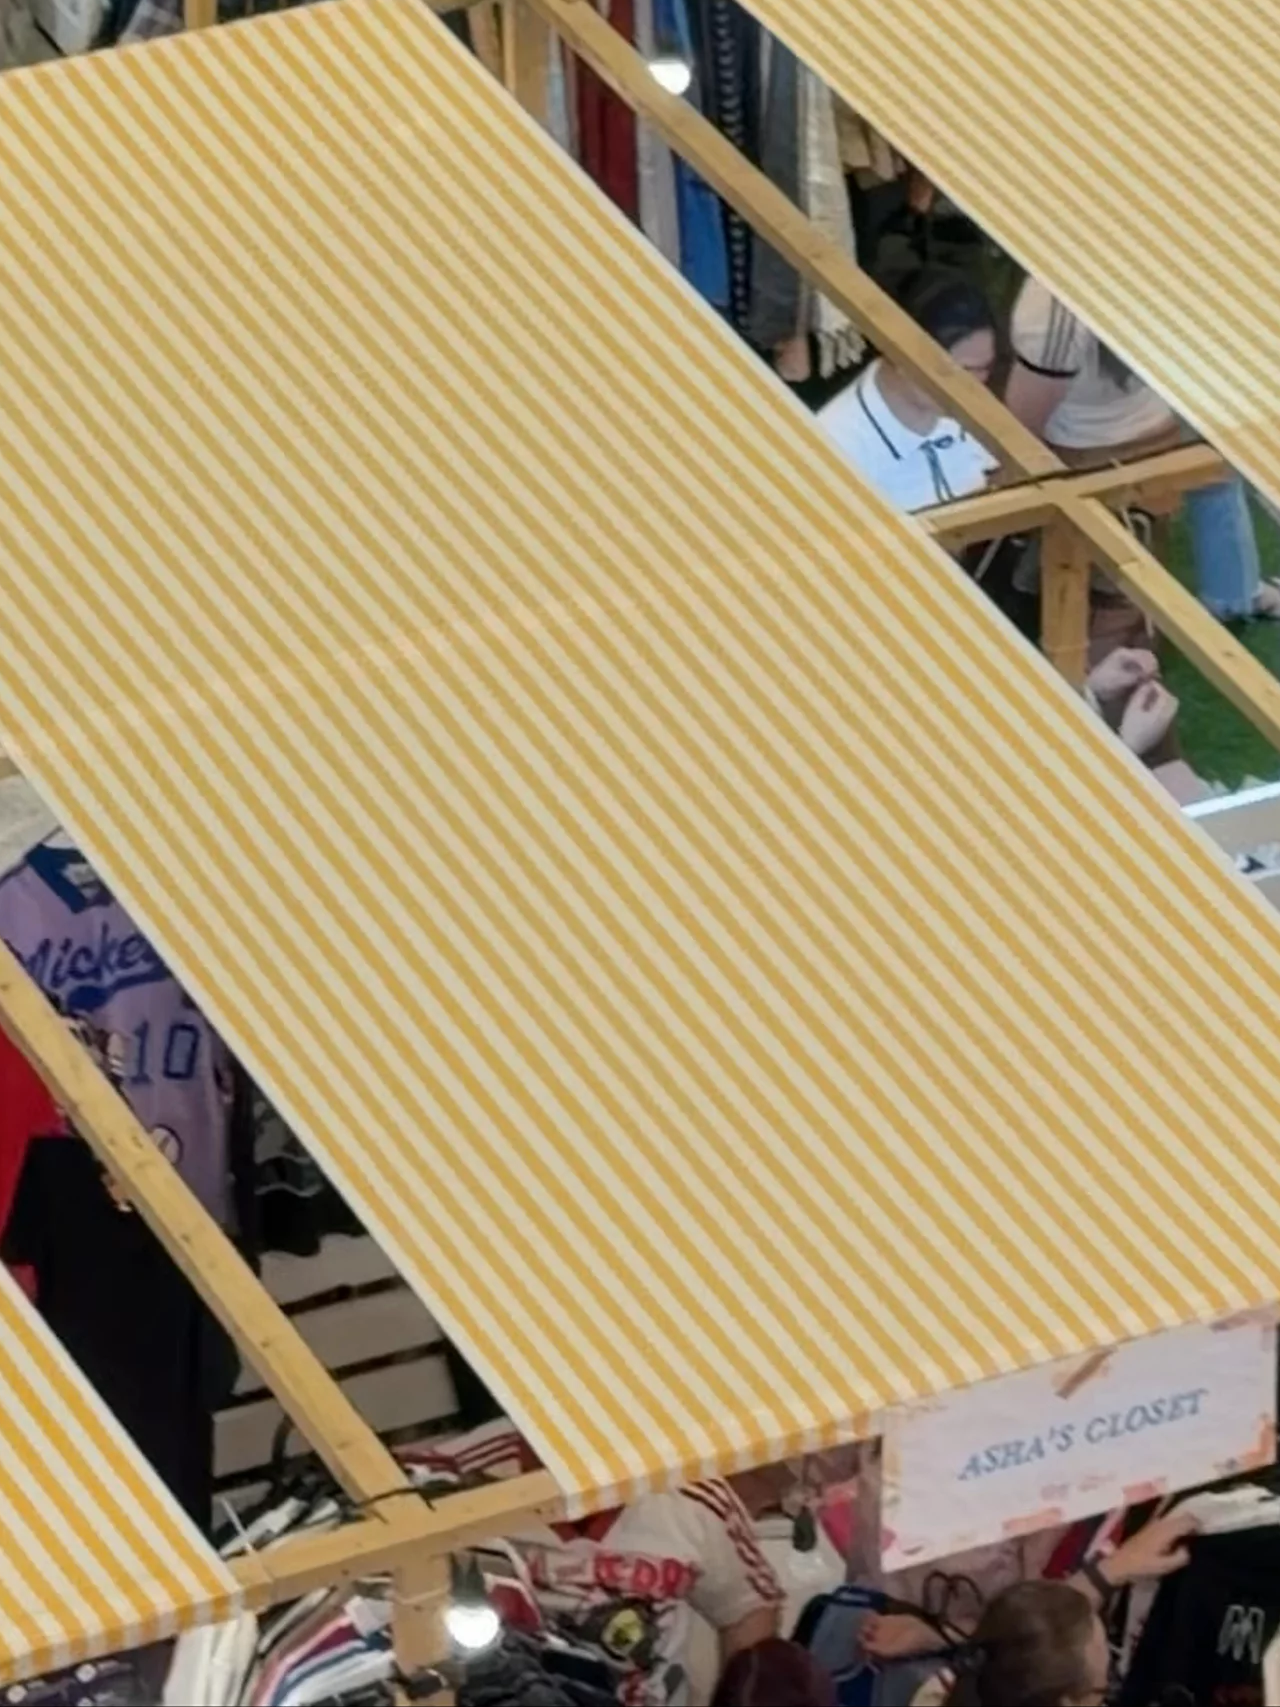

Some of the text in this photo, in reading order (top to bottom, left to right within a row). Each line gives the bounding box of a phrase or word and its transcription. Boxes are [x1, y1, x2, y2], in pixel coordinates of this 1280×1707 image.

[130, 1019, 200, 1085] 10
[956, 1388, 1210, 1482] ASHA'S CLOSET
